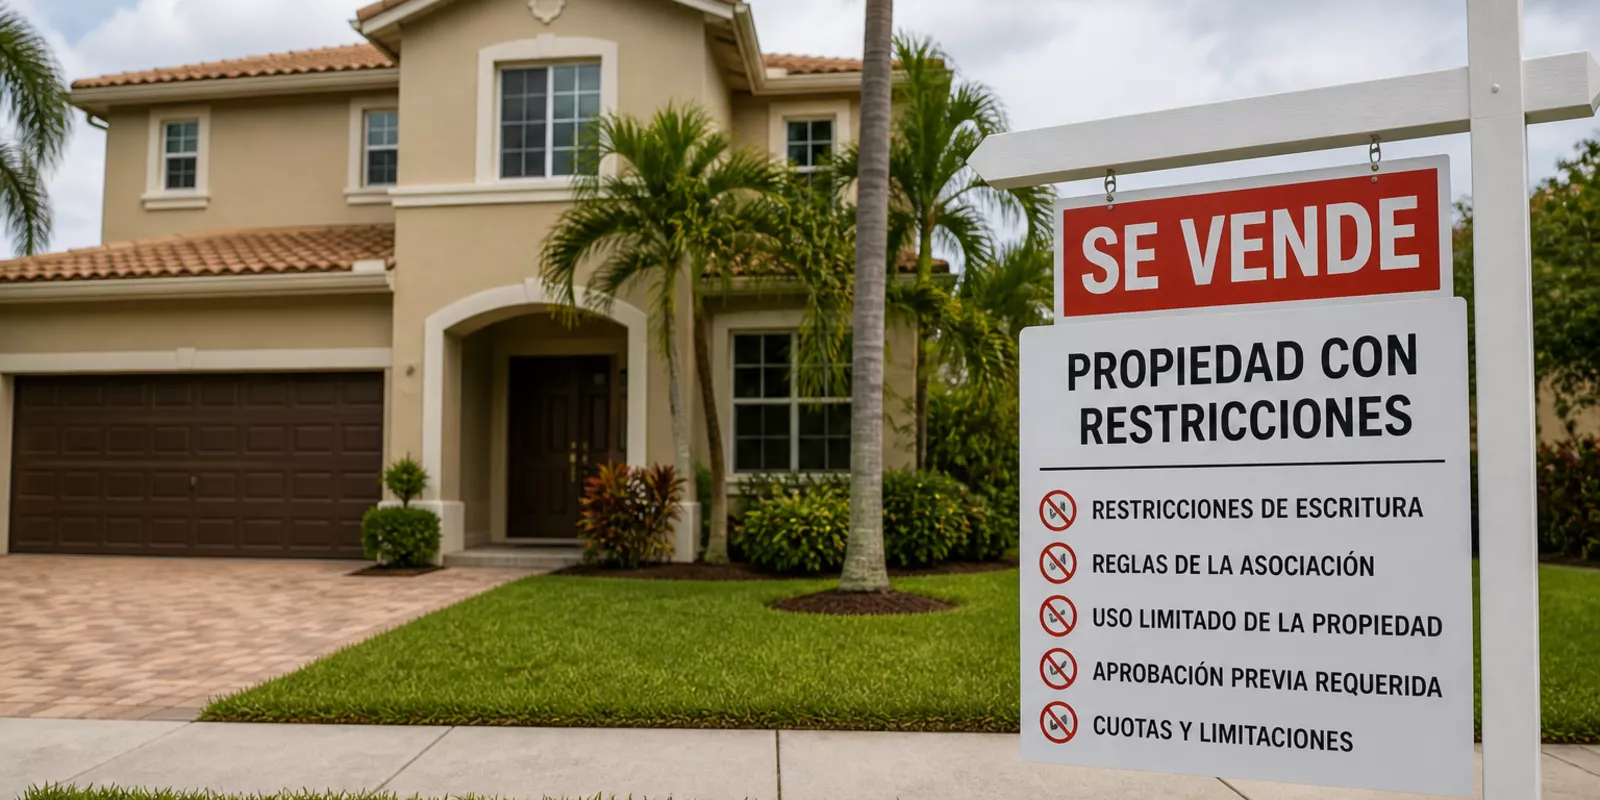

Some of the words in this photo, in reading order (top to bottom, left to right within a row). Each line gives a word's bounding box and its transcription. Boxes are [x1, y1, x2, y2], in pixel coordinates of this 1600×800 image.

[1081, 221, 1159, 295] SE
[1179, 195, 1420, 286] VENDE
[1068, 340, 1304, 392] PROPIEDAD
[1321, 332, 1417, 380] CON
[1080, 394, 1413, 446] RESTRICCIONES
[1092, 498, 1254, 520] RESTRICCIONES
[1261, 498, 1289, 519] DE
[1296, 496, 1424, 519] ESCRITURA
[1092, 553, 1168, 575] REGLAS
[1175, 554, 1201, 575] DE
[1208, 555, 1233, 576] LA
[1240, 550, 1375, 577] ASOCIACIÓN
[1092, 607, 1133, 628] USO
[1139, 609, 1237, 631] LIMITADO
[1244, 611, 1271, 632] DE
[1278, 612, 1305, 633] LA
[1312, 612, 1443, 637] PROPIEDAD
[1092, 661, 1224, 687] APROBACIÓN
[1231, 667, 1308, 692] PREVIA
[1315, 671, 1443, 698] REQUERIDA
[1093, 715, 1173, 740] CUOTAS
[1179, 720, 1193, 742] Y
[1200, 722, 1354, 753] LIMITACIONES
